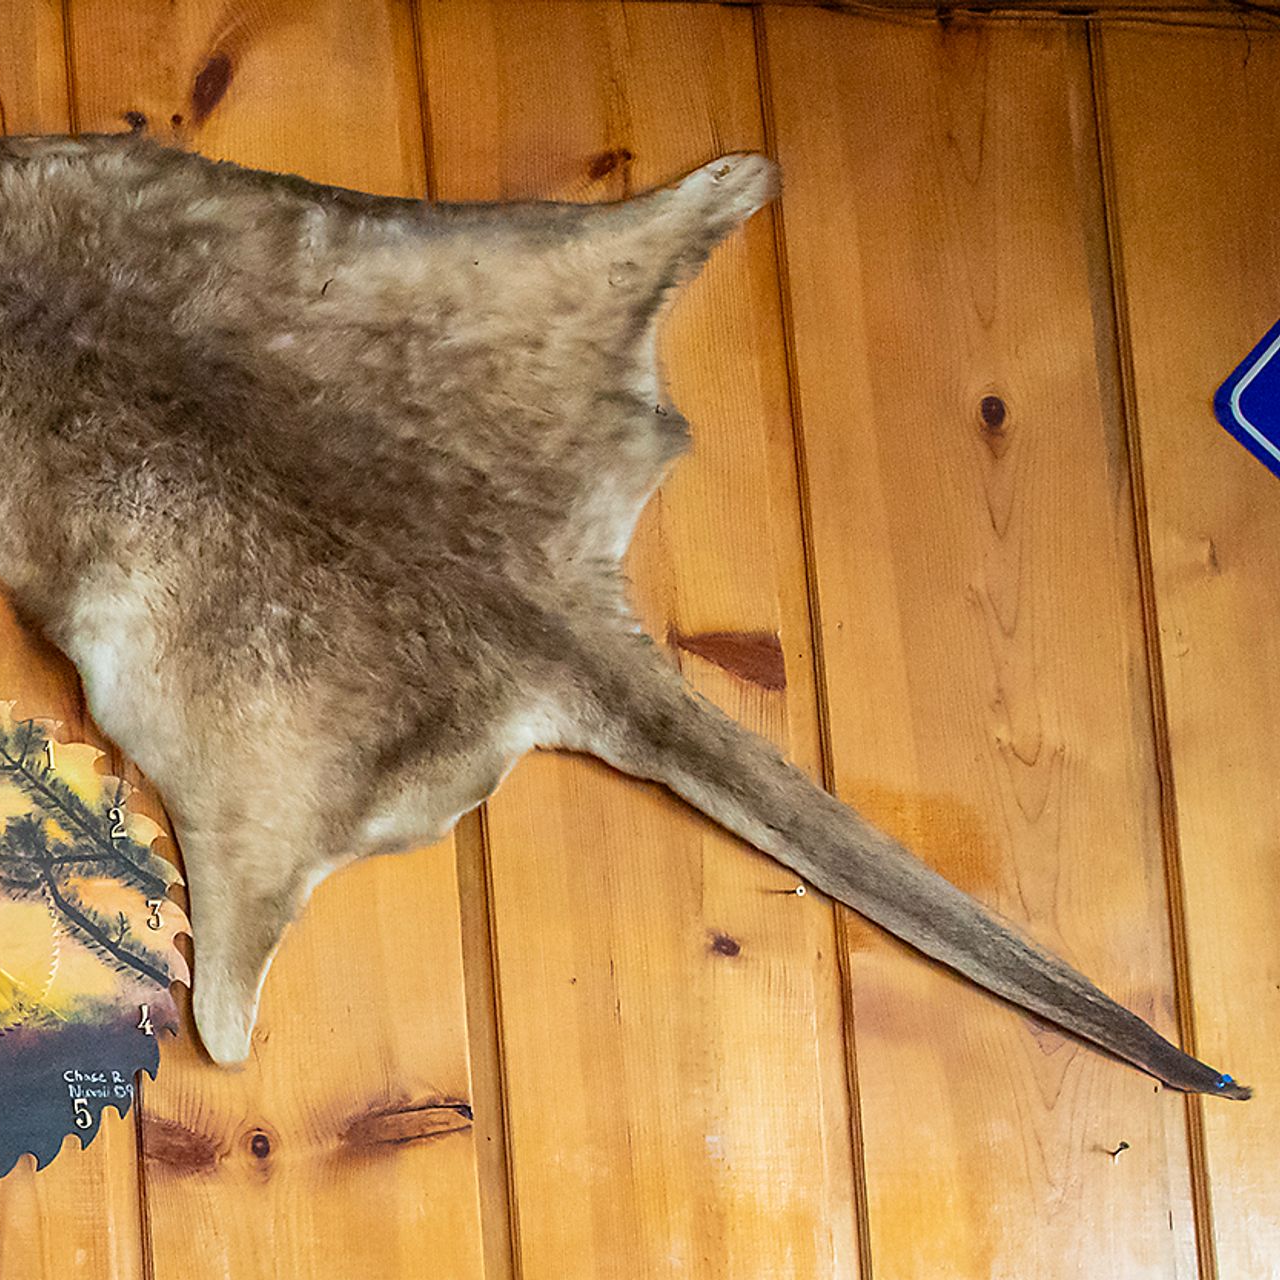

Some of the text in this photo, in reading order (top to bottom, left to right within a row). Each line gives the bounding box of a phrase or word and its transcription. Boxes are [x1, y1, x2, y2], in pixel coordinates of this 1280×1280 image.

[45, 739, 57, 770] 1
[108, 808, 127, 839] 2
[145, 899, 164, 931] 3
[137, 1005, 154, 1036] 4
[74, 1098, 93, 1129] 5
